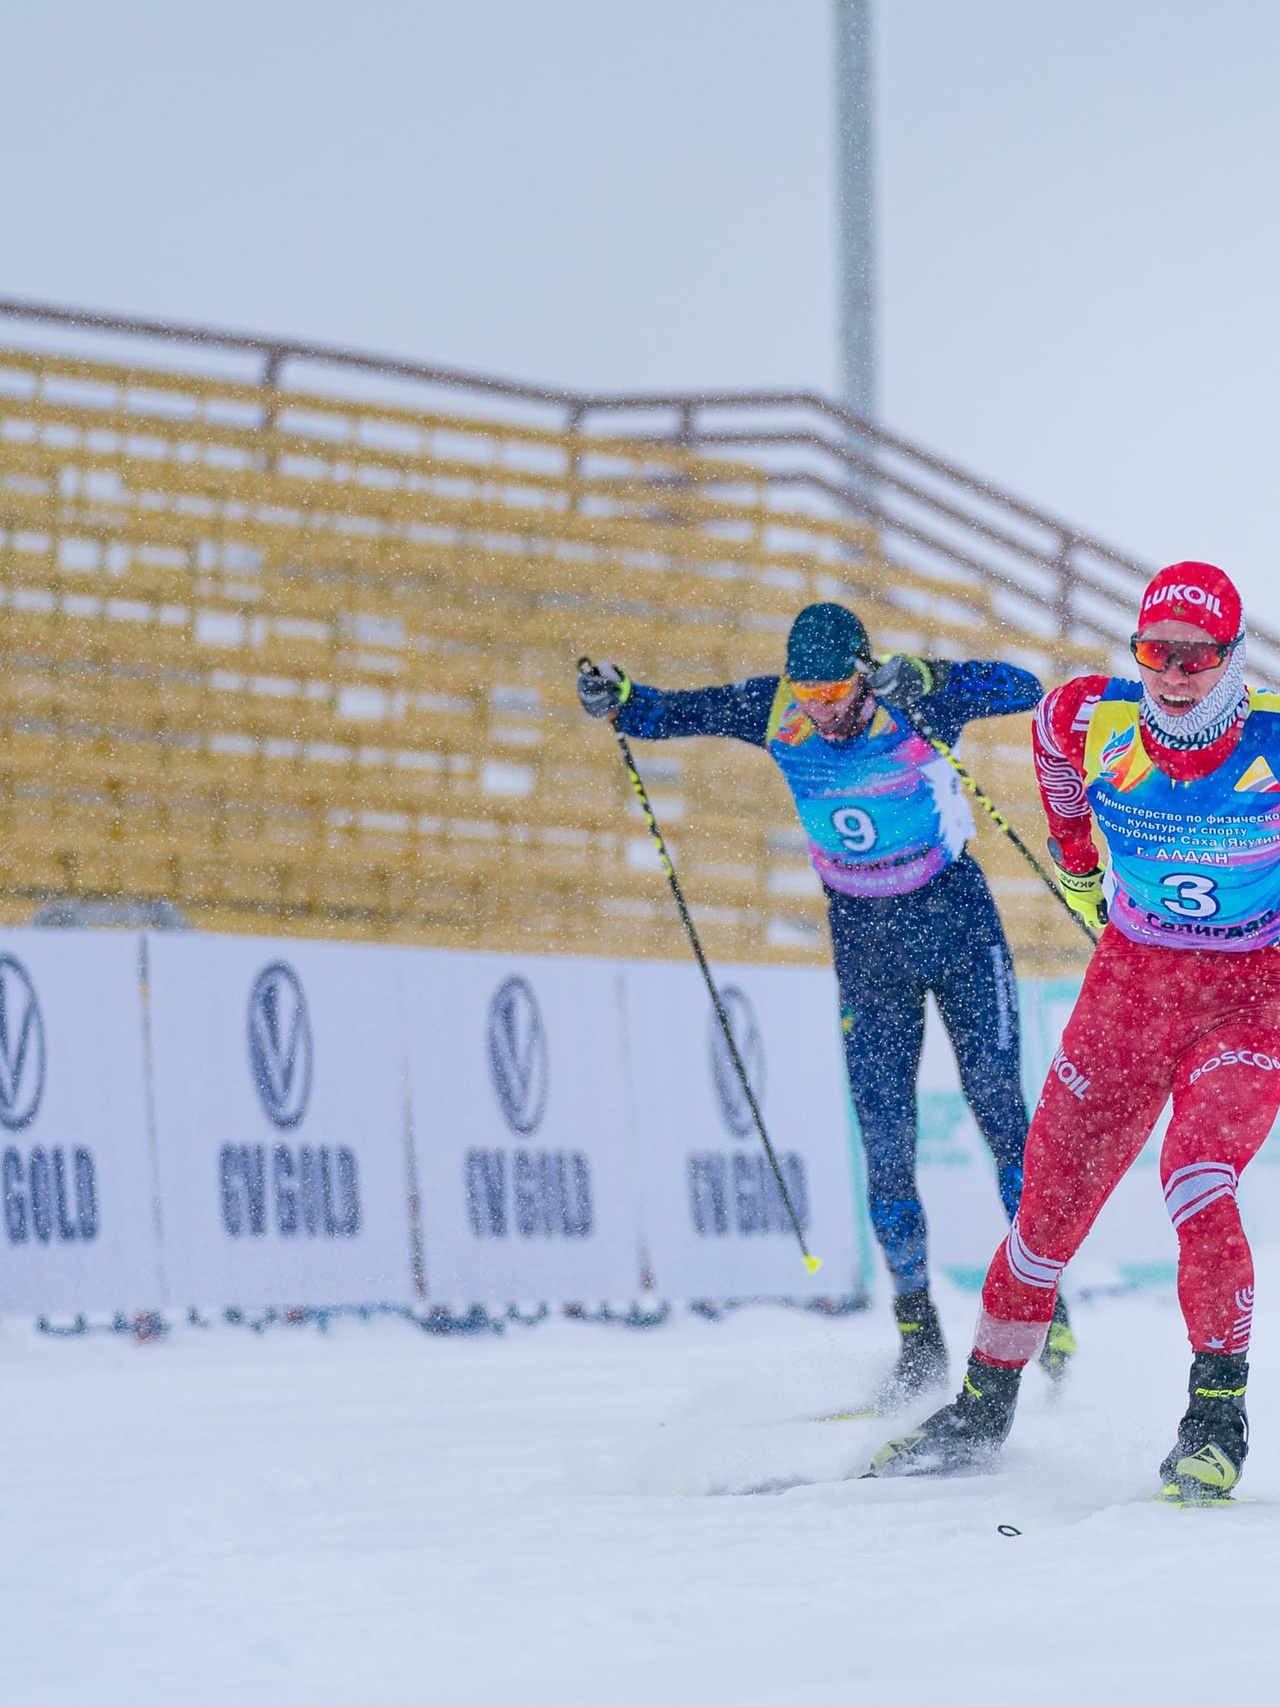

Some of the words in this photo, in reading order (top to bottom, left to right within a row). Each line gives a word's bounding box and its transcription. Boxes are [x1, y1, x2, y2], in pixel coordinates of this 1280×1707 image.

[1144, 584, 1223, 619] LUKOIL
[1095, 790, 1182, 823] Министерство
[1186, 813, 1203, 824] по
[832, 807, 877, 852] 9
[1098, 813, 1176, 844] Республики
[1180, 835, 1218, 848] Саха
[1126, 818, 1184, 834] культуре
[1200, 826, 1248, 837] спорту
[1136, 846, 1150, 858] г.
[1156, 849, 1229, 865] АЛДАН
[1160, 873, 1220, 918] 3
[1188, 1050, 1275, 1085] BOSCO
[3, 1146, 98, 1241] GOLD
